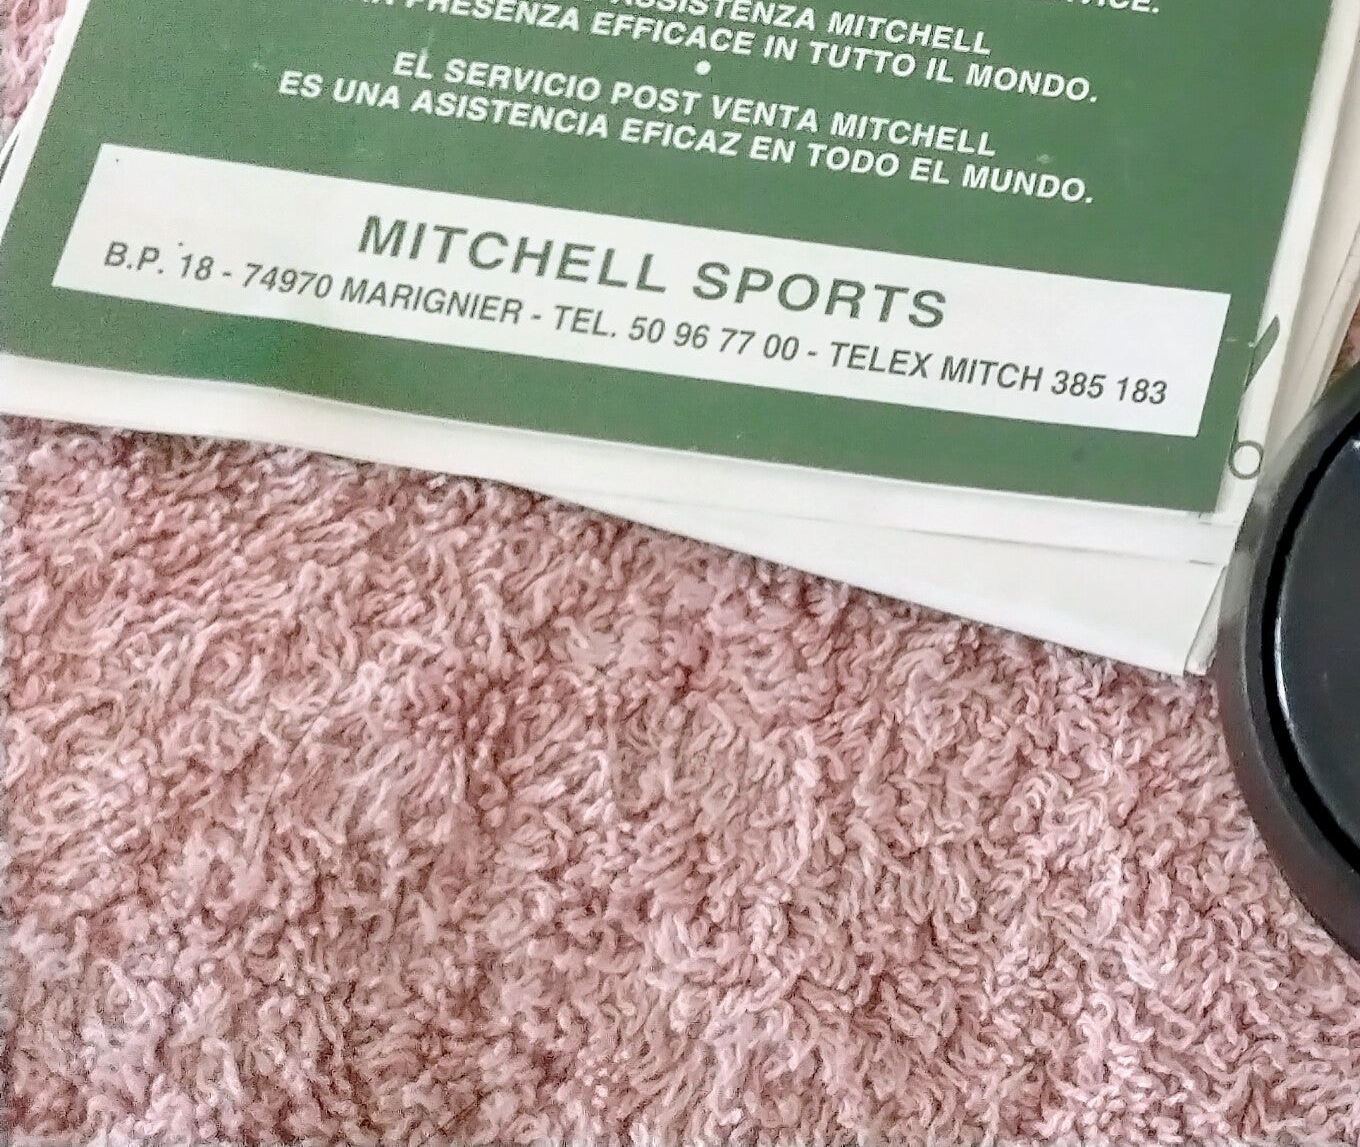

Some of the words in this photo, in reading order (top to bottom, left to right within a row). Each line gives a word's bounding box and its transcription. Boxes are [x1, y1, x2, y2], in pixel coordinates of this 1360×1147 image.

[589, 11, 756, 56] EFFICACE
[762, 34, 798, 62] IN
[808, 39, 916, 78] TUTTO
[925, 57, 954, 83] IL
[965, 62, 1097, 103] MONDO.
[826, 10, 991, 56] MITCHELL
[277, 69, 324, 99] ES
[332, 77, 401, 110] UNA
[409, 88, 609, 139] ASISTENCIA
[618, 117, 743, 157] EFICAZ
[748, 135, 797, 164] EN
[807, 142, 900, 177] TODO
[908, 156, 950, 185] EL
[961, 163, 1093, 204] MUNDO.
[390, 52, 434, 81] EL
[443, 57, 602, 103] SERVICIO
[609, 81, 703, 116] POST
[711, 94, 818, 133] VENTA
[829, 111, 996, 157] MITCHELL
[104, 241, 164, 274] B.P.
[181, 254, 214, 281] 18
[244, 262, 333, 298] 74970
[340, 277, 523, 324] MARIGNIER
[555, 304, 617, 339] TEL.
[628, 316, 666, 344] 50
[674, 322, 710, 349] 96
[720, 327, 757, 355] 77
[763, 334, 800, 361] 00
[831, 341, 933, 378] TELEX
[940, 356, 1044, 392] MITCH
[1051, 369, 1107, 399] 385
[1118, 377, 1168, 405] 183
[358, 215, 665, 294] MITCHELL
[693, 261, 946, 329] SPORTS
